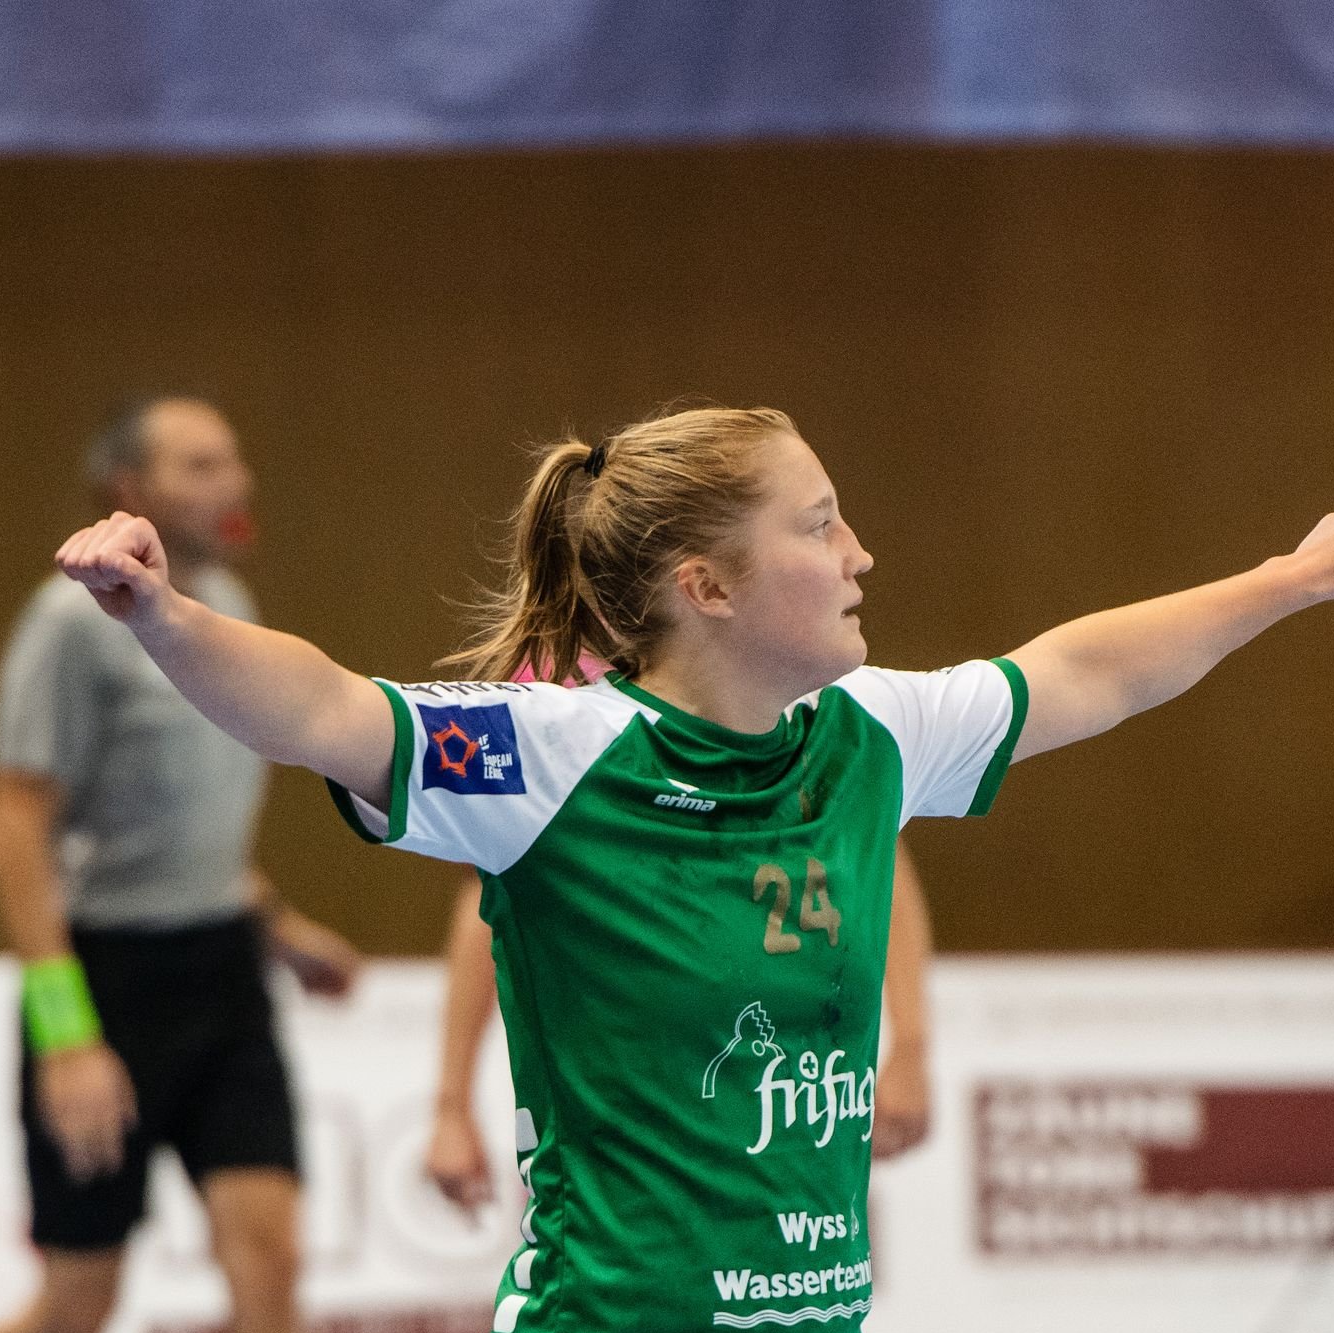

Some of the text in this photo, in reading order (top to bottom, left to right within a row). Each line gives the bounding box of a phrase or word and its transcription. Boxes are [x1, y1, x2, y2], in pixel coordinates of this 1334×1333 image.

[653, 792, 717, 812] erima
[752, 856, 842, 955] 24
[777, 1211, 848, 1252] Wyss
